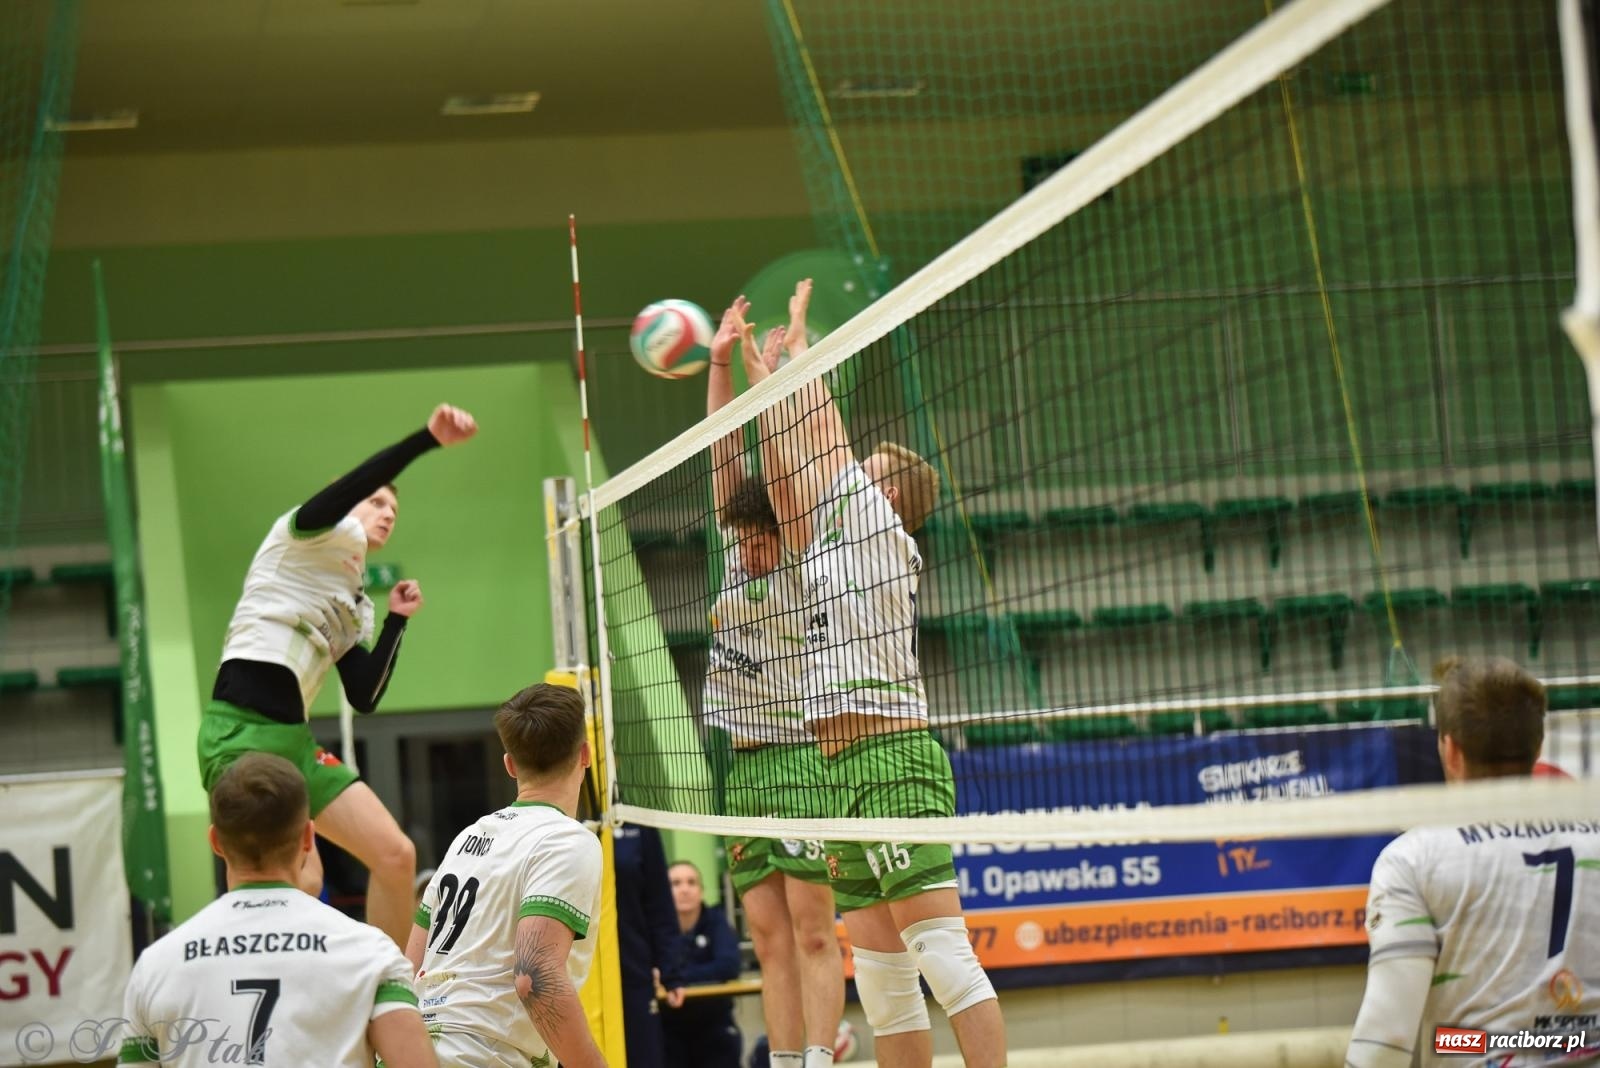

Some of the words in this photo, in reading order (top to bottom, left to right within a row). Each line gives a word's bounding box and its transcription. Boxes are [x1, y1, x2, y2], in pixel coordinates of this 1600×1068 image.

[879, 841, 911, 873] 15
[983, 859, 1117, 901] Opawska
[1122, 856, 1161, 885] 55
[1522, 846, 1575, 960] 7
[184, 932, 328, 963] BŁASZCZOK
[1044, 907, 1367, 946] ubezpieczenia-raciborz.p
[231, 978, 280, 1065] 7
